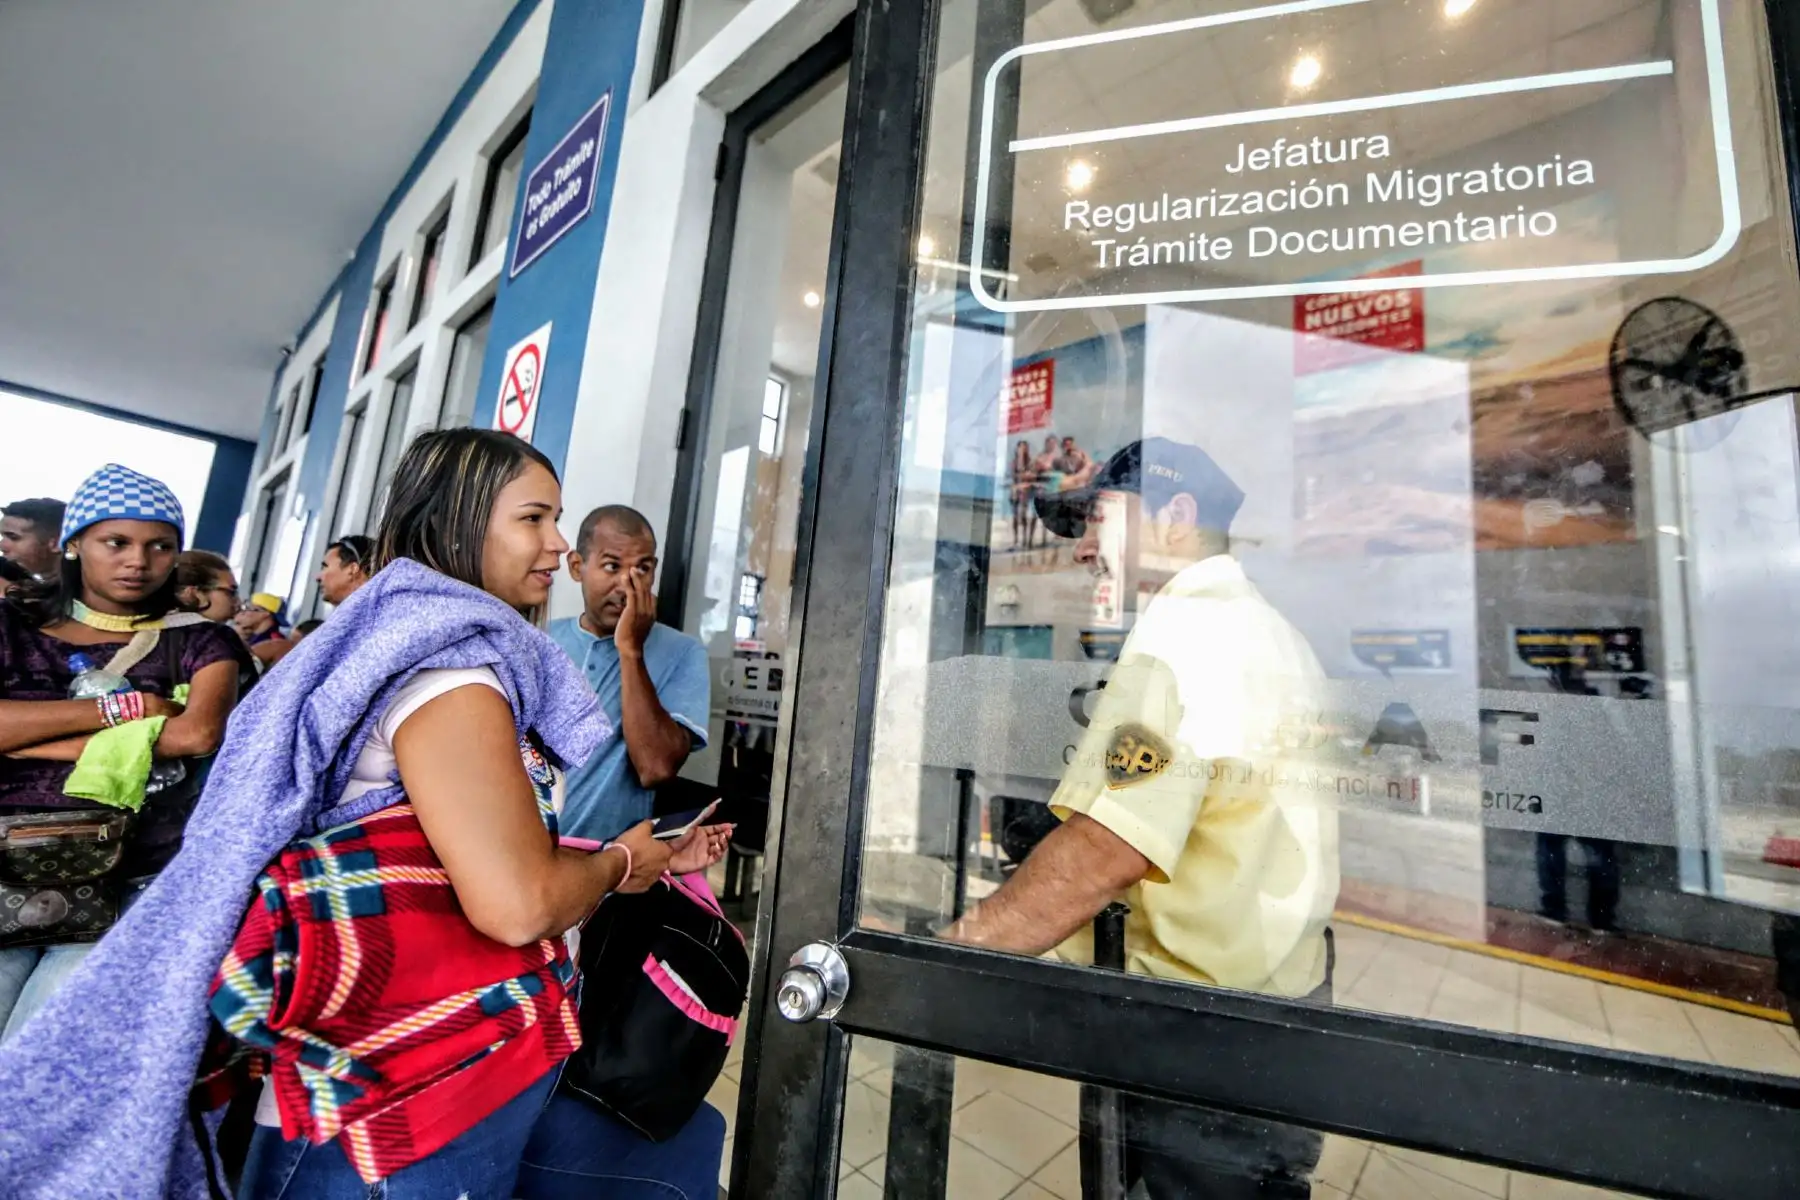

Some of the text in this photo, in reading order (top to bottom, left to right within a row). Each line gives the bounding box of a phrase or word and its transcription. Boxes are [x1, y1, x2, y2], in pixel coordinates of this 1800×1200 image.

[1225, 134, 1391, 173] Jefatura
[527, 181, 551, 216] Todo
[539, 178, 581, 228] Gratuito
[1064, 154, 1595, 233] Regularización Migratoria
[1091, 205, 1558, 268] Trámite Documentario
[1304, 290, 1412, 331] NUEVOS
[1148, 463, 1183, 482] PERU
